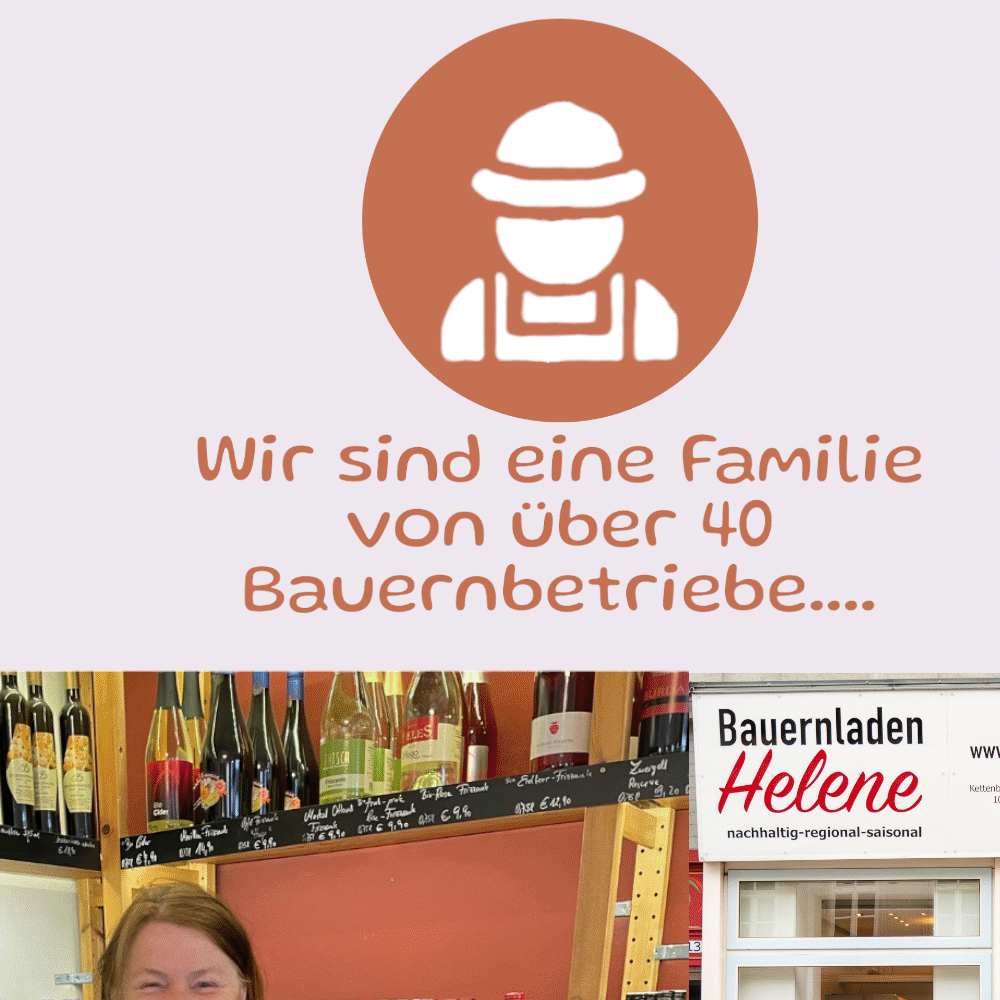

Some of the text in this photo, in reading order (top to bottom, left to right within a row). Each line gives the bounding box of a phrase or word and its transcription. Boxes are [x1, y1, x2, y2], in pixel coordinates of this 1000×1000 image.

[718, 706, 924, 747] Bauernladen
[717, 748, 924, 815] Helene
[727, 826, 922, 841] nachhaltig-regional-saisonal
